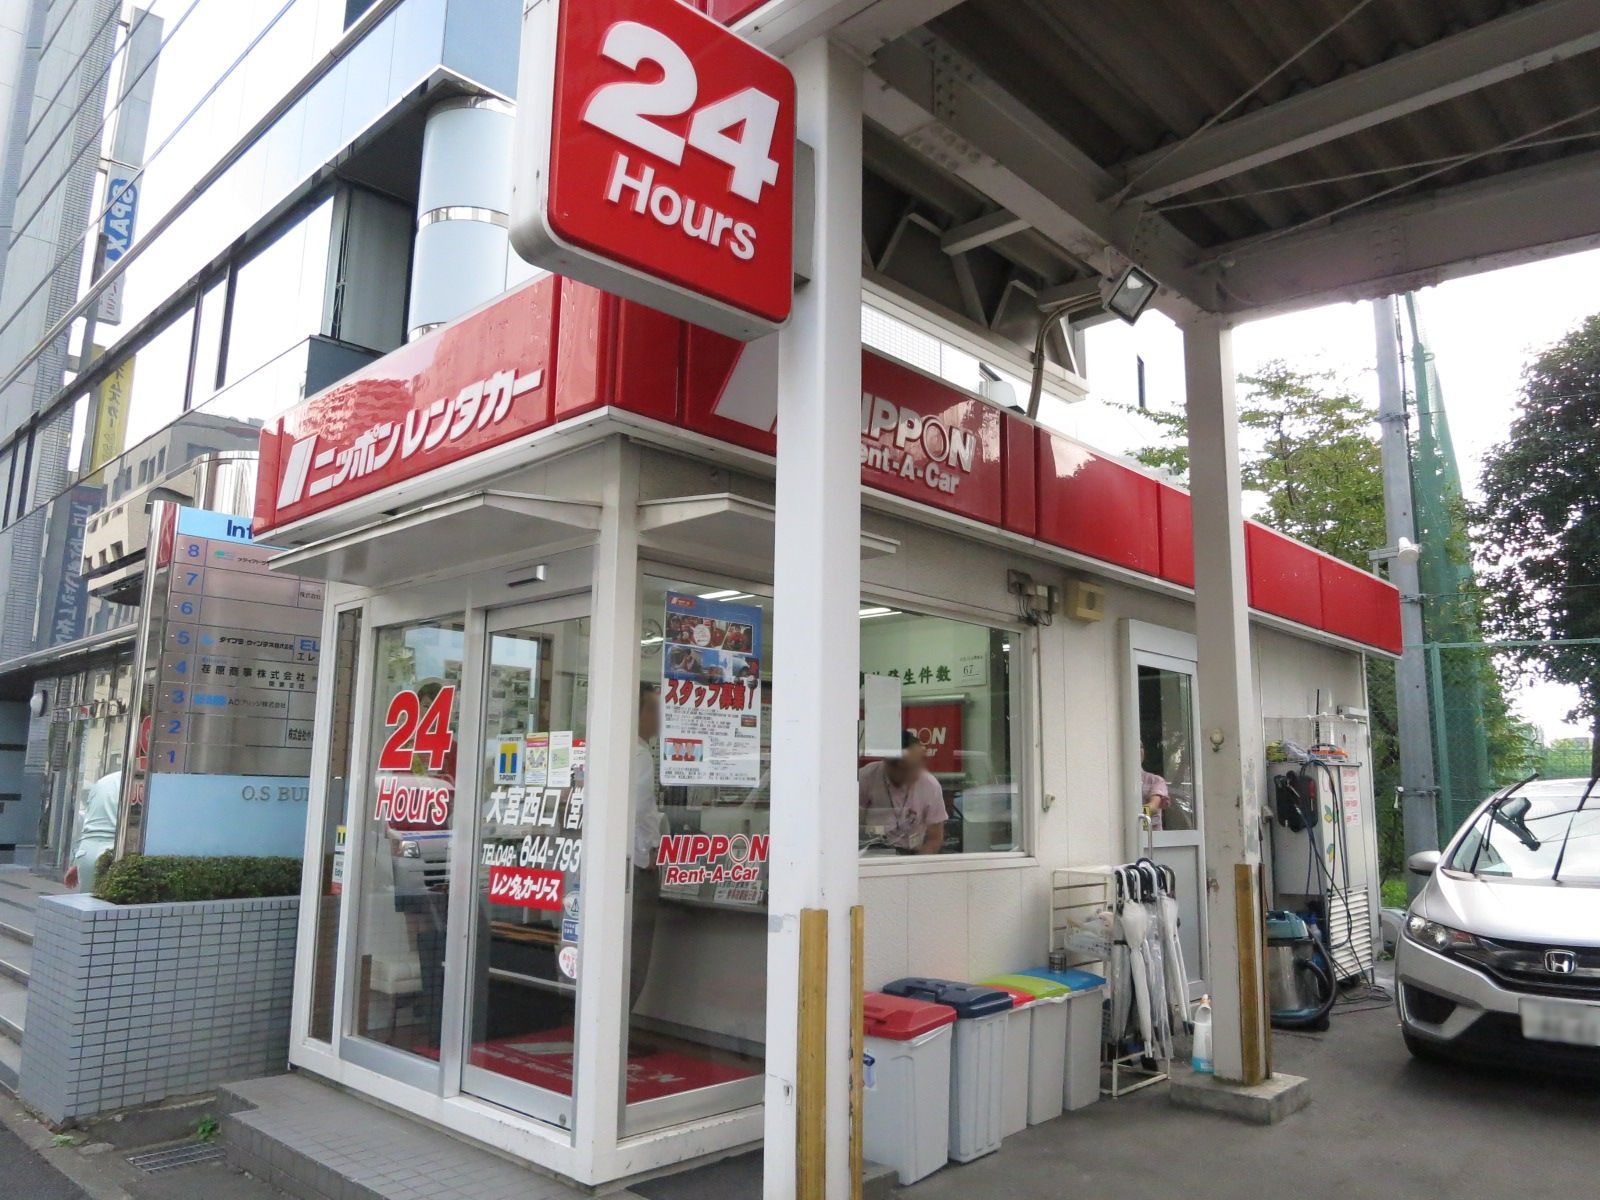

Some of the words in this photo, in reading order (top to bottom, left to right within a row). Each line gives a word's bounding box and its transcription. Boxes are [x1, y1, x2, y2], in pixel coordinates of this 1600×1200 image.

[582, 21, 780, 204] 24
[605, 152, 757, 261] Hours
[309, 369, 545, 497] ニッポンレンタカー
[188, 544, 199, 557] 8
[186, 572, 198, 586] 7
[181, 601, 193, 615] 6
[177, 630, 190, 645] 5
[175, 660, 187, 674] 4
[172, 689, 185, 704] 3
[168, 720, 181, 734] 2
[378, 685, 455, 771] 24
[167, 751, 176, 764] 1
[374, 776, 450, 826] Hours
[656, 834, 769, 865] NIPPON
[664, 864, 760, 885] Rent-A-Car
